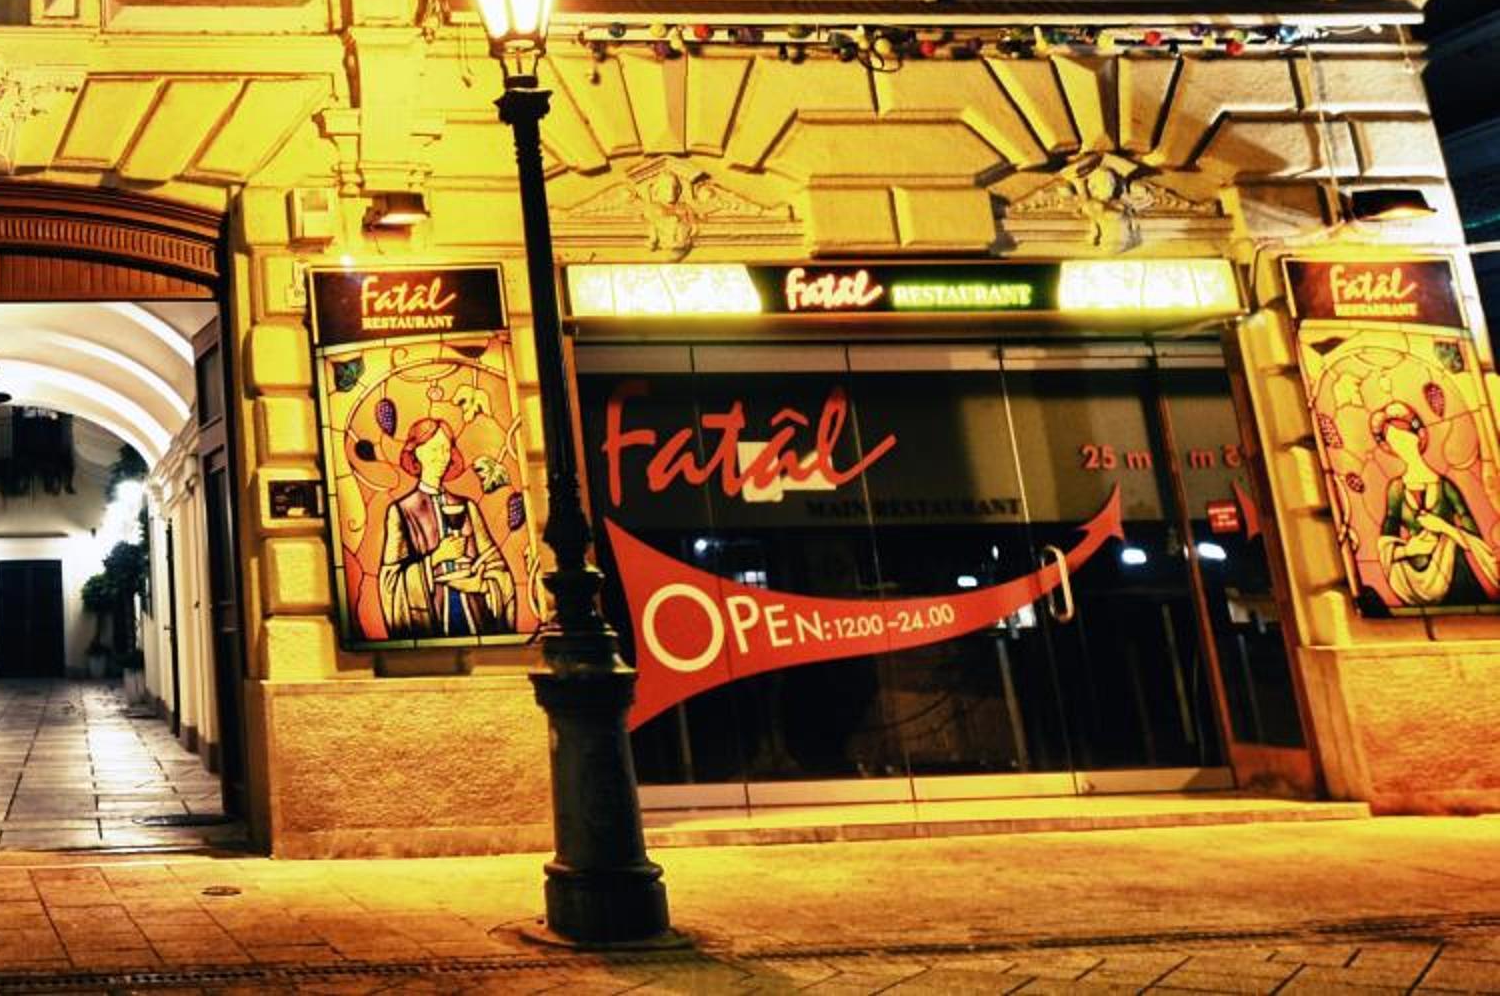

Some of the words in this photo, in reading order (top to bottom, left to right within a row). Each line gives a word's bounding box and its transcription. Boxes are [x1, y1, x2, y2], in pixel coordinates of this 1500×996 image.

[891, 284, 1032, 306] RESTAURANT
[361, 316, 454, 330] RESTAURANT
[1080, 443, 1117, 470] 25
[1126, 449, 1152, 470] m
